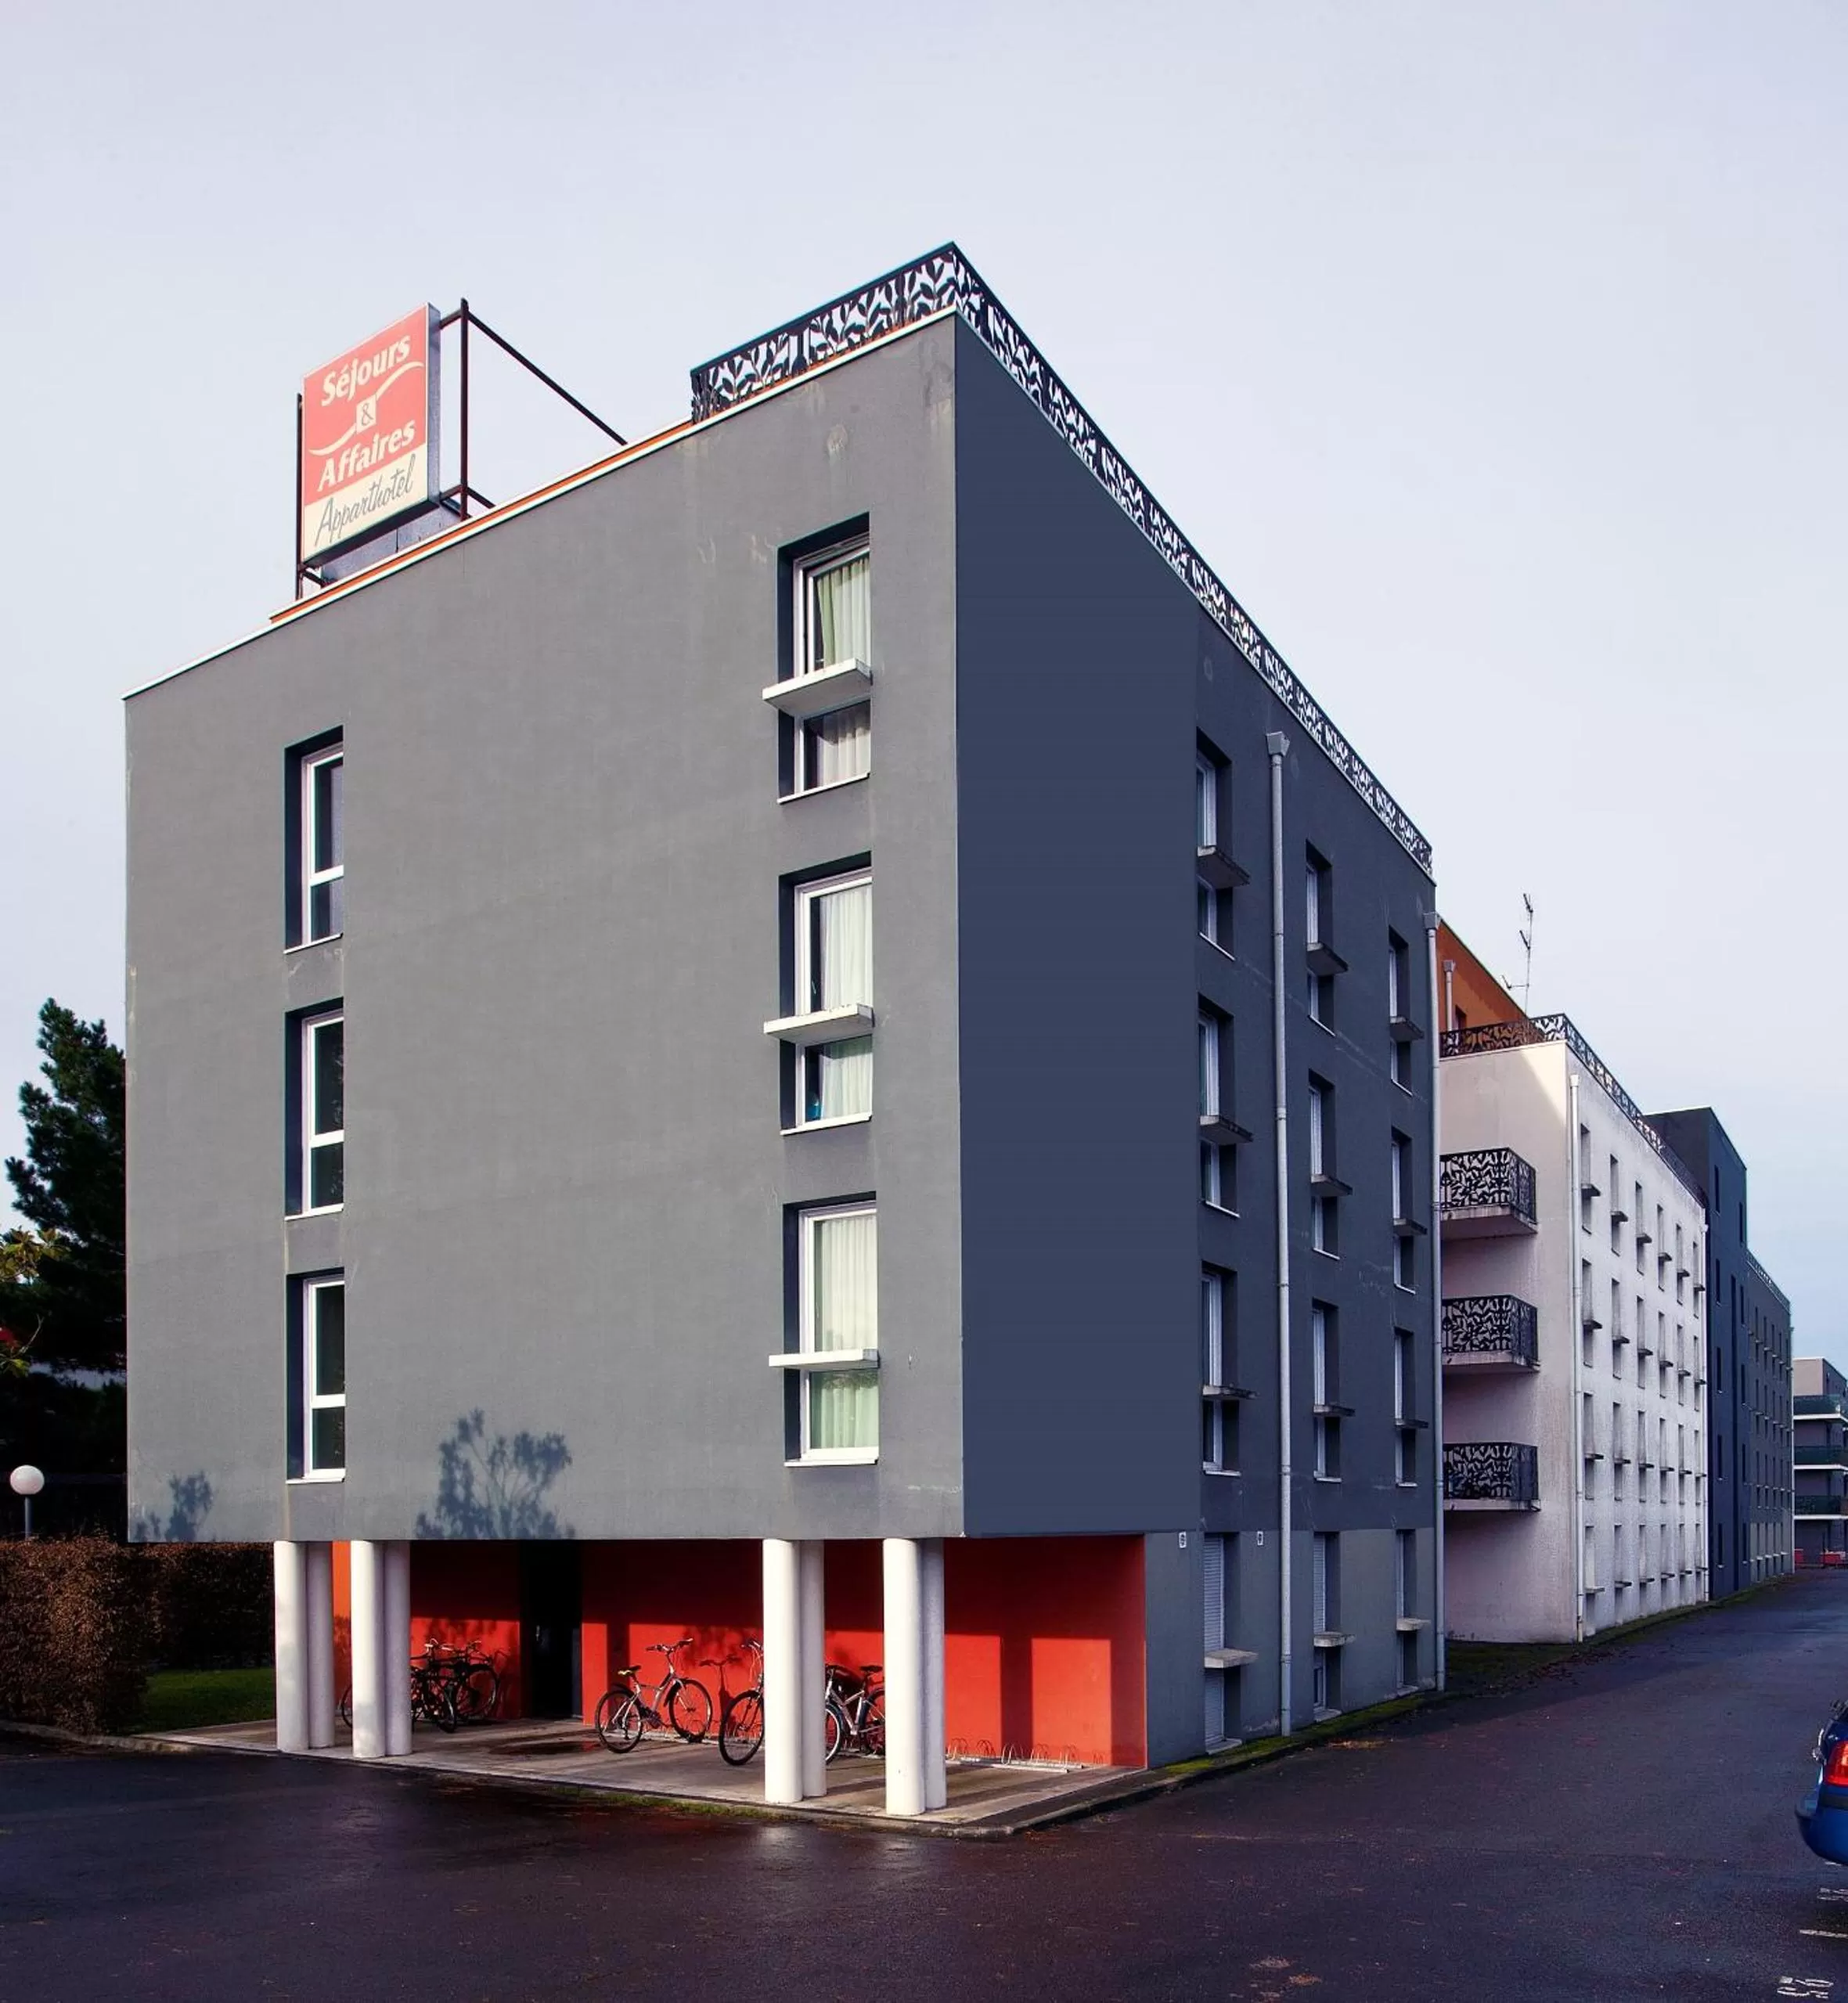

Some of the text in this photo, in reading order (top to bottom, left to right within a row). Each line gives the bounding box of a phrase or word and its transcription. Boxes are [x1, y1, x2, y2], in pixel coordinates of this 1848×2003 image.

[321, 335, 410, 406] Séjours
[361, 402, 374, 426] &
[317, 420, 415, 492] Affaires
